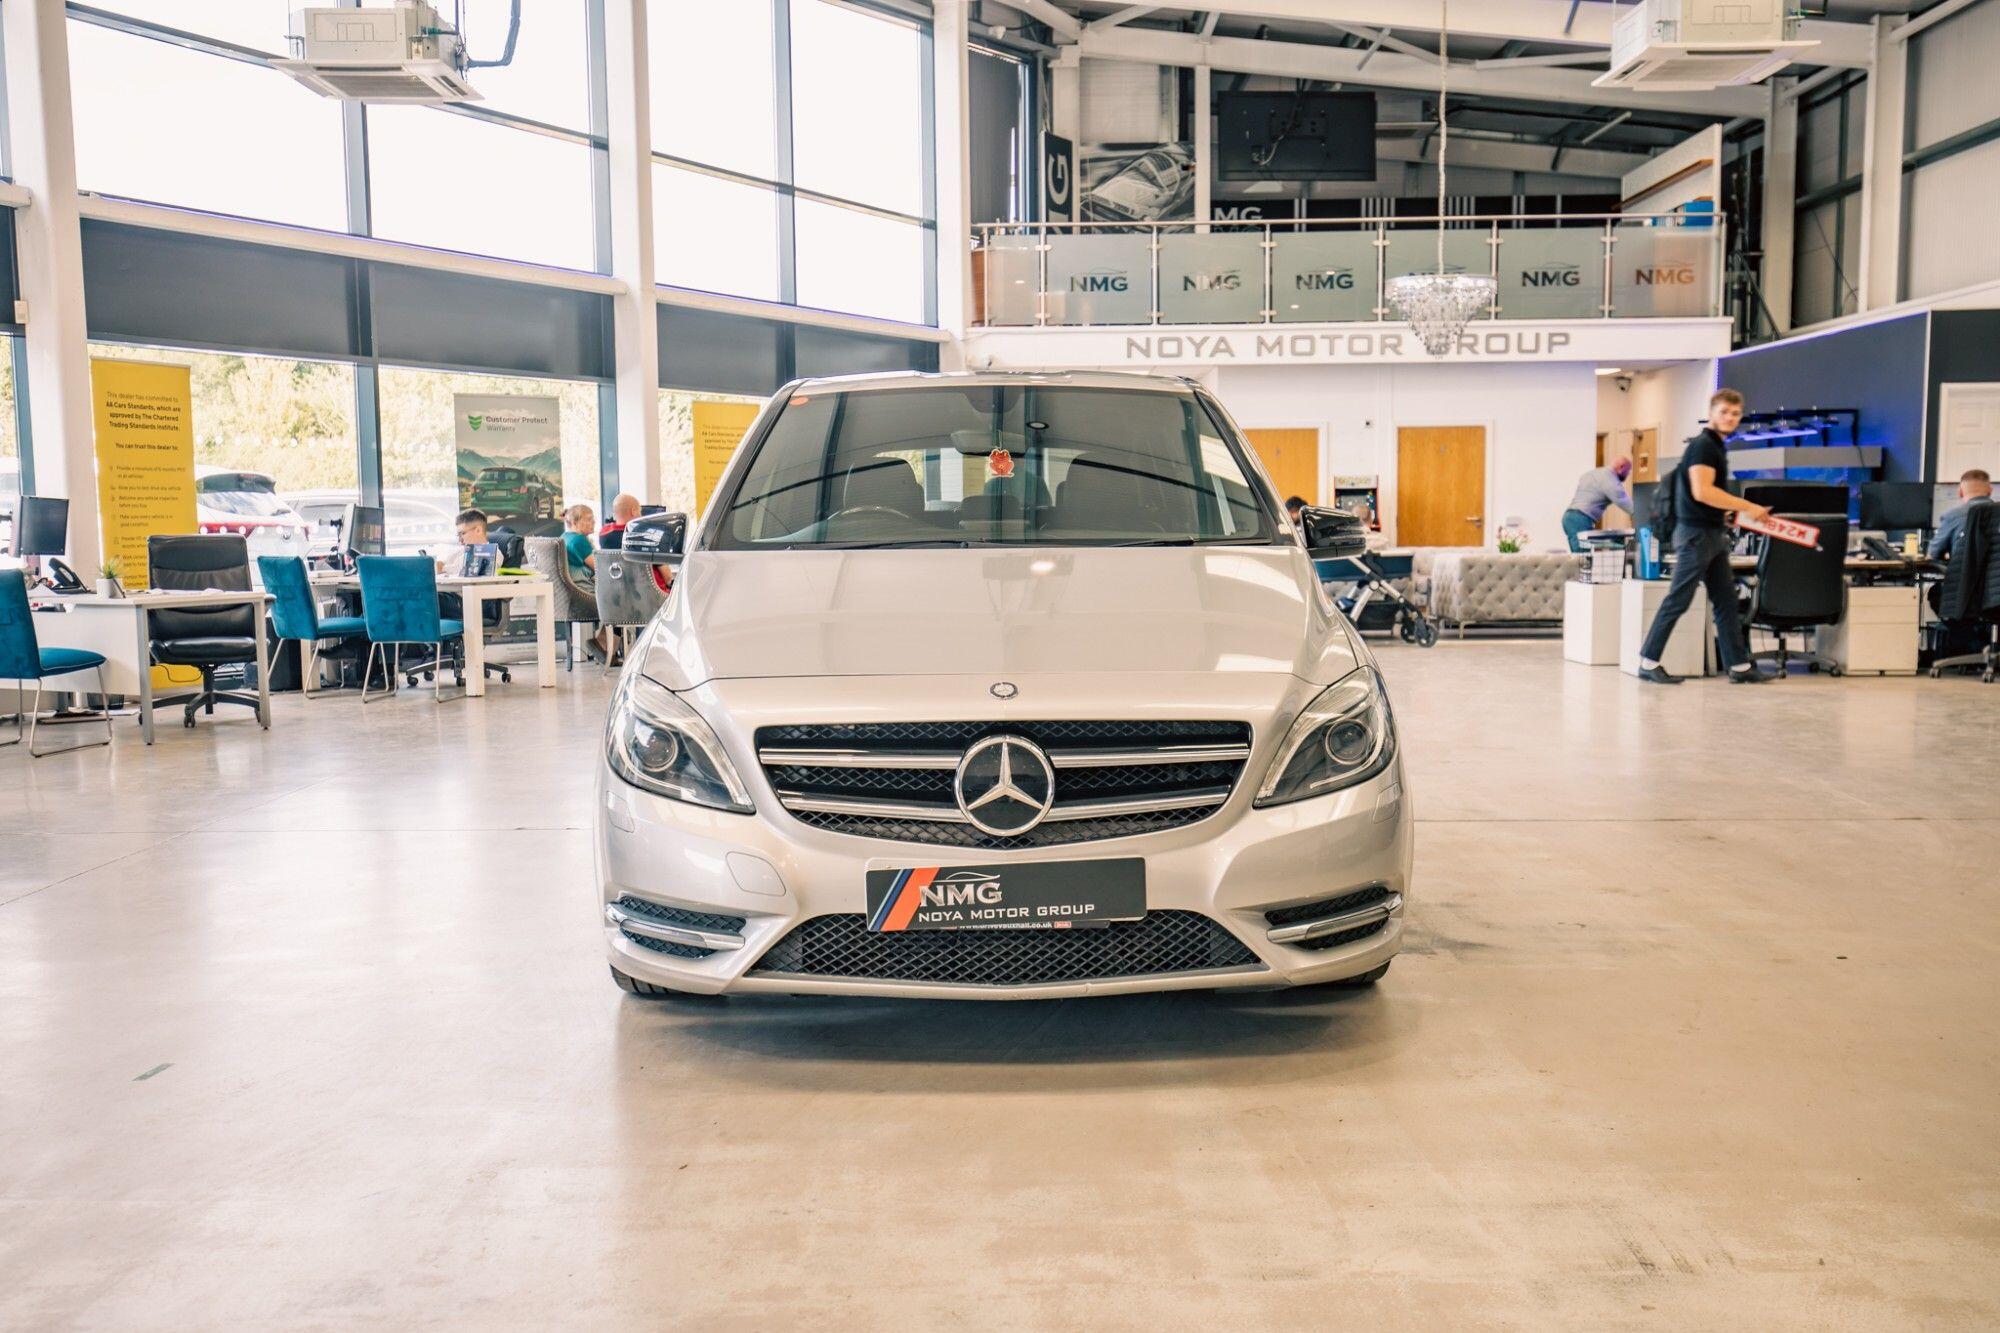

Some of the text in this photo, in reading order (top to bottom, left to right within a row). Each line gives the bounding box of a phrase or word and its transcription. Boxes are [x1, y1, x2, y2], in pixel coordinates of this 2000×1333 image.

[1070, 275, 1128, 292] NMG
[1296, 274, 1354, 290] NMG
[1521, 270, 1580, 287] NMG
[1635, 268, 1695, 285] NMG
[1126, 335, 1235, 358] NOYA
[1256, 334, 1403, 357] MOTOR
[109, 420, 128, 429] Trading
[129, 422, 156, 430] Standards
[485, 415, 548, 424] Customer Protect
[486, 424, 516, 433] Warranty
[918, 882, 1003, 907] NMG
[919, 904, 1096, 922] NOYA MOTOR GROUP
